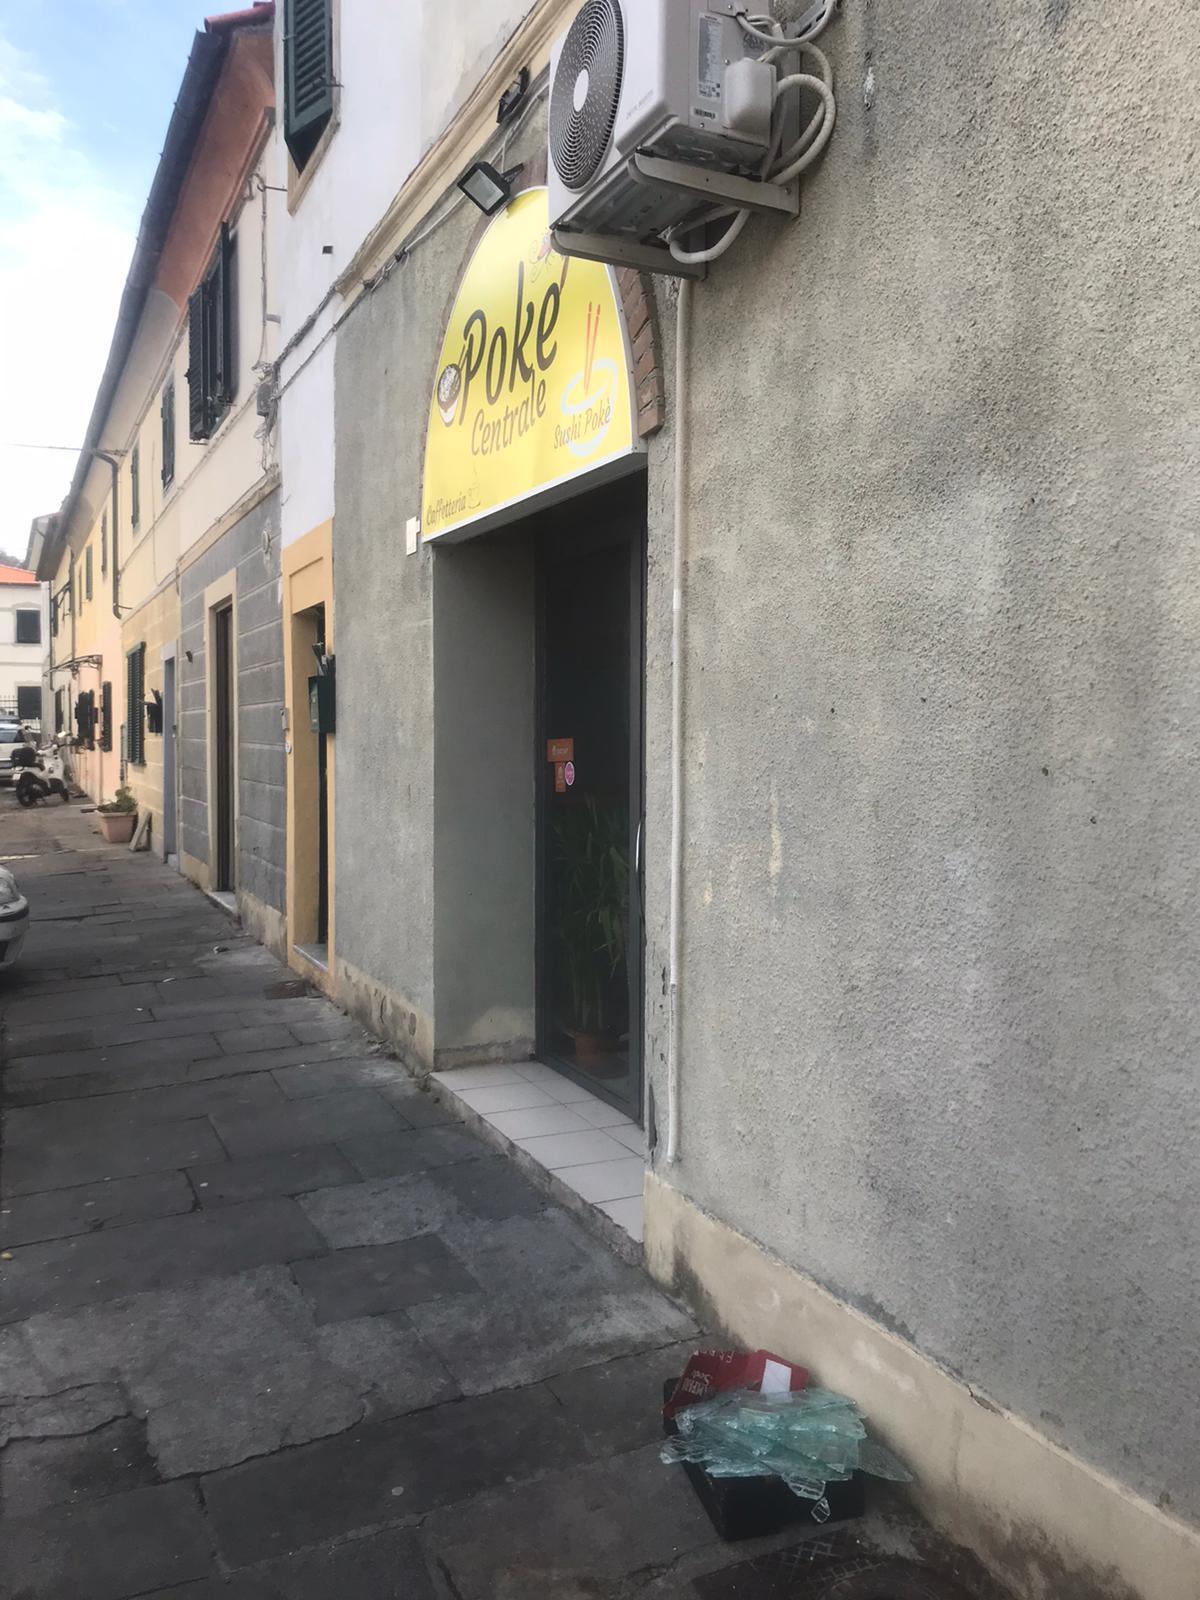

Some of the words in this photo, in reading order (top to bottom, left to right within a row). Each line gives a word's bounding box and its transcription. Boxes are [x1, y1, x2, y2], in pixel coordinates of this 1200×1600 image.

[471, 367, 547, 456] Centrale
[553, 413, 582, 449] Sushi
[426, 491, 467, 526] Caffetteria
